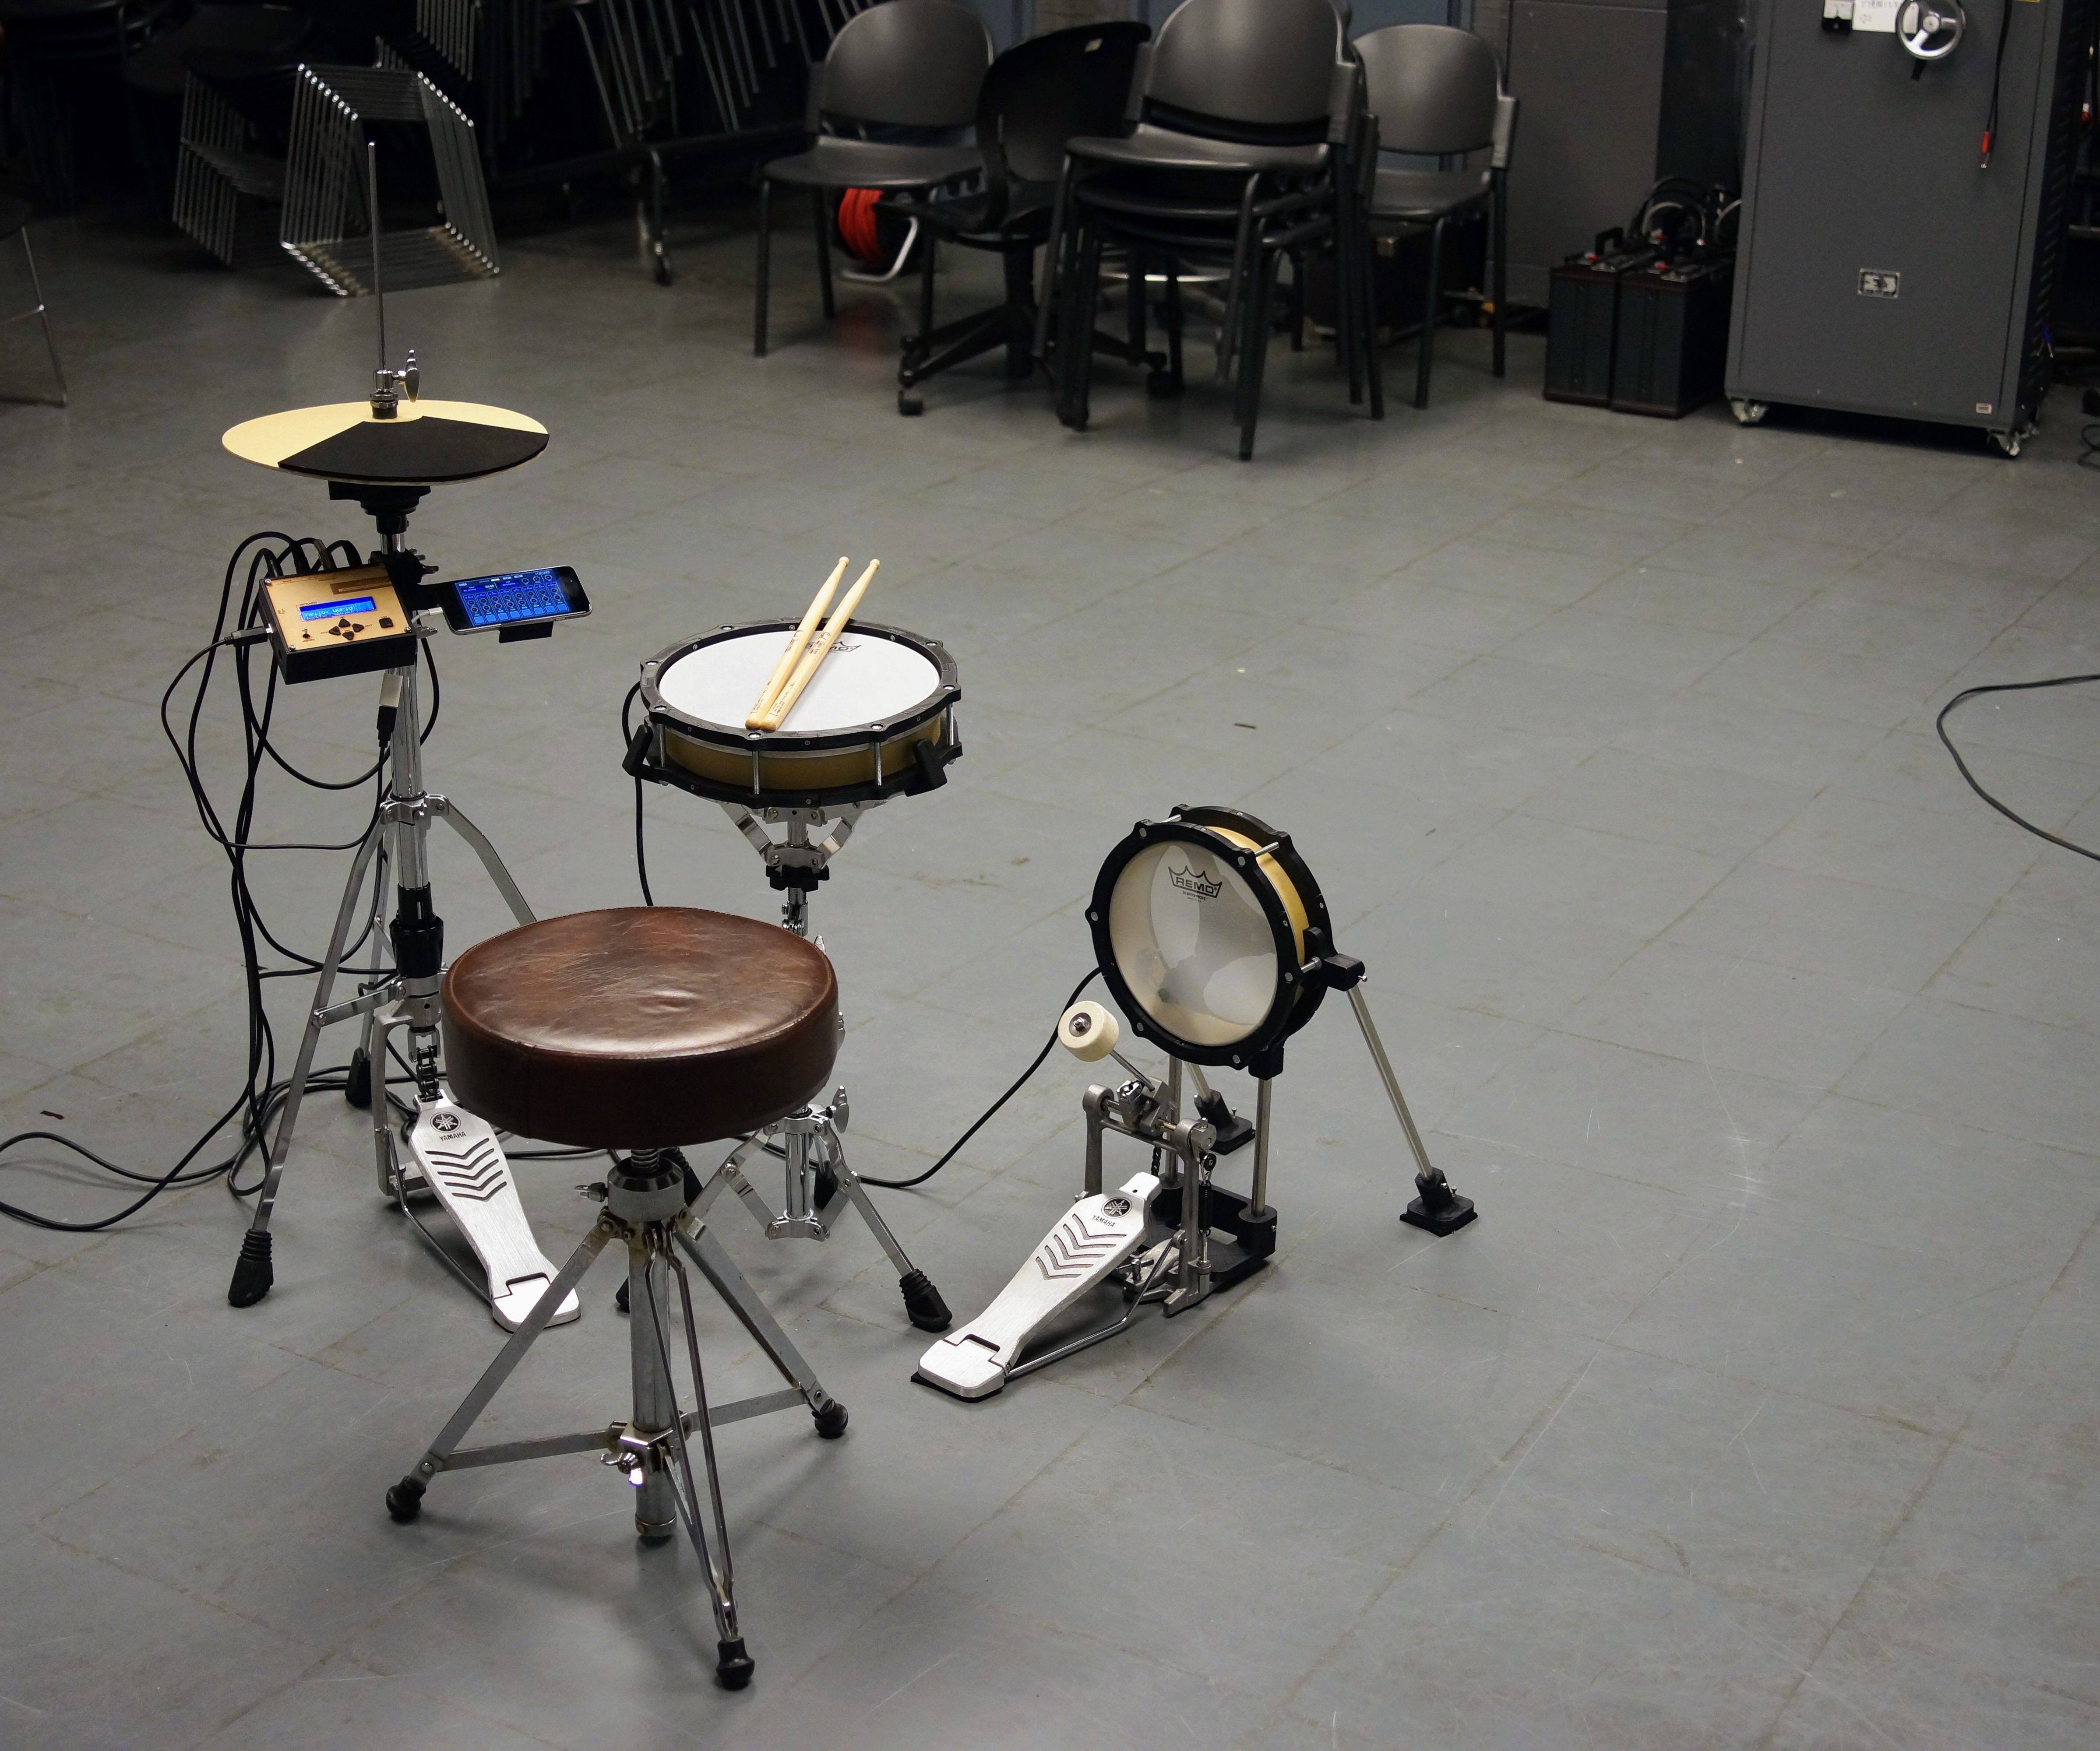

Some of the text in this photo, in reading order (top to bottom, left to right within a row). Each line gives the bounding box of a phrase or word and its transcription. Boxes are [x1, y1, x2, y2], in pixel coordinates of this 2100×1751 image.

[1176, 876, 1214, 894] REMO
[439, 1131, 467, 1141] YAMAHA
[1092, 1214, 1116, 1227] YAMAHA
